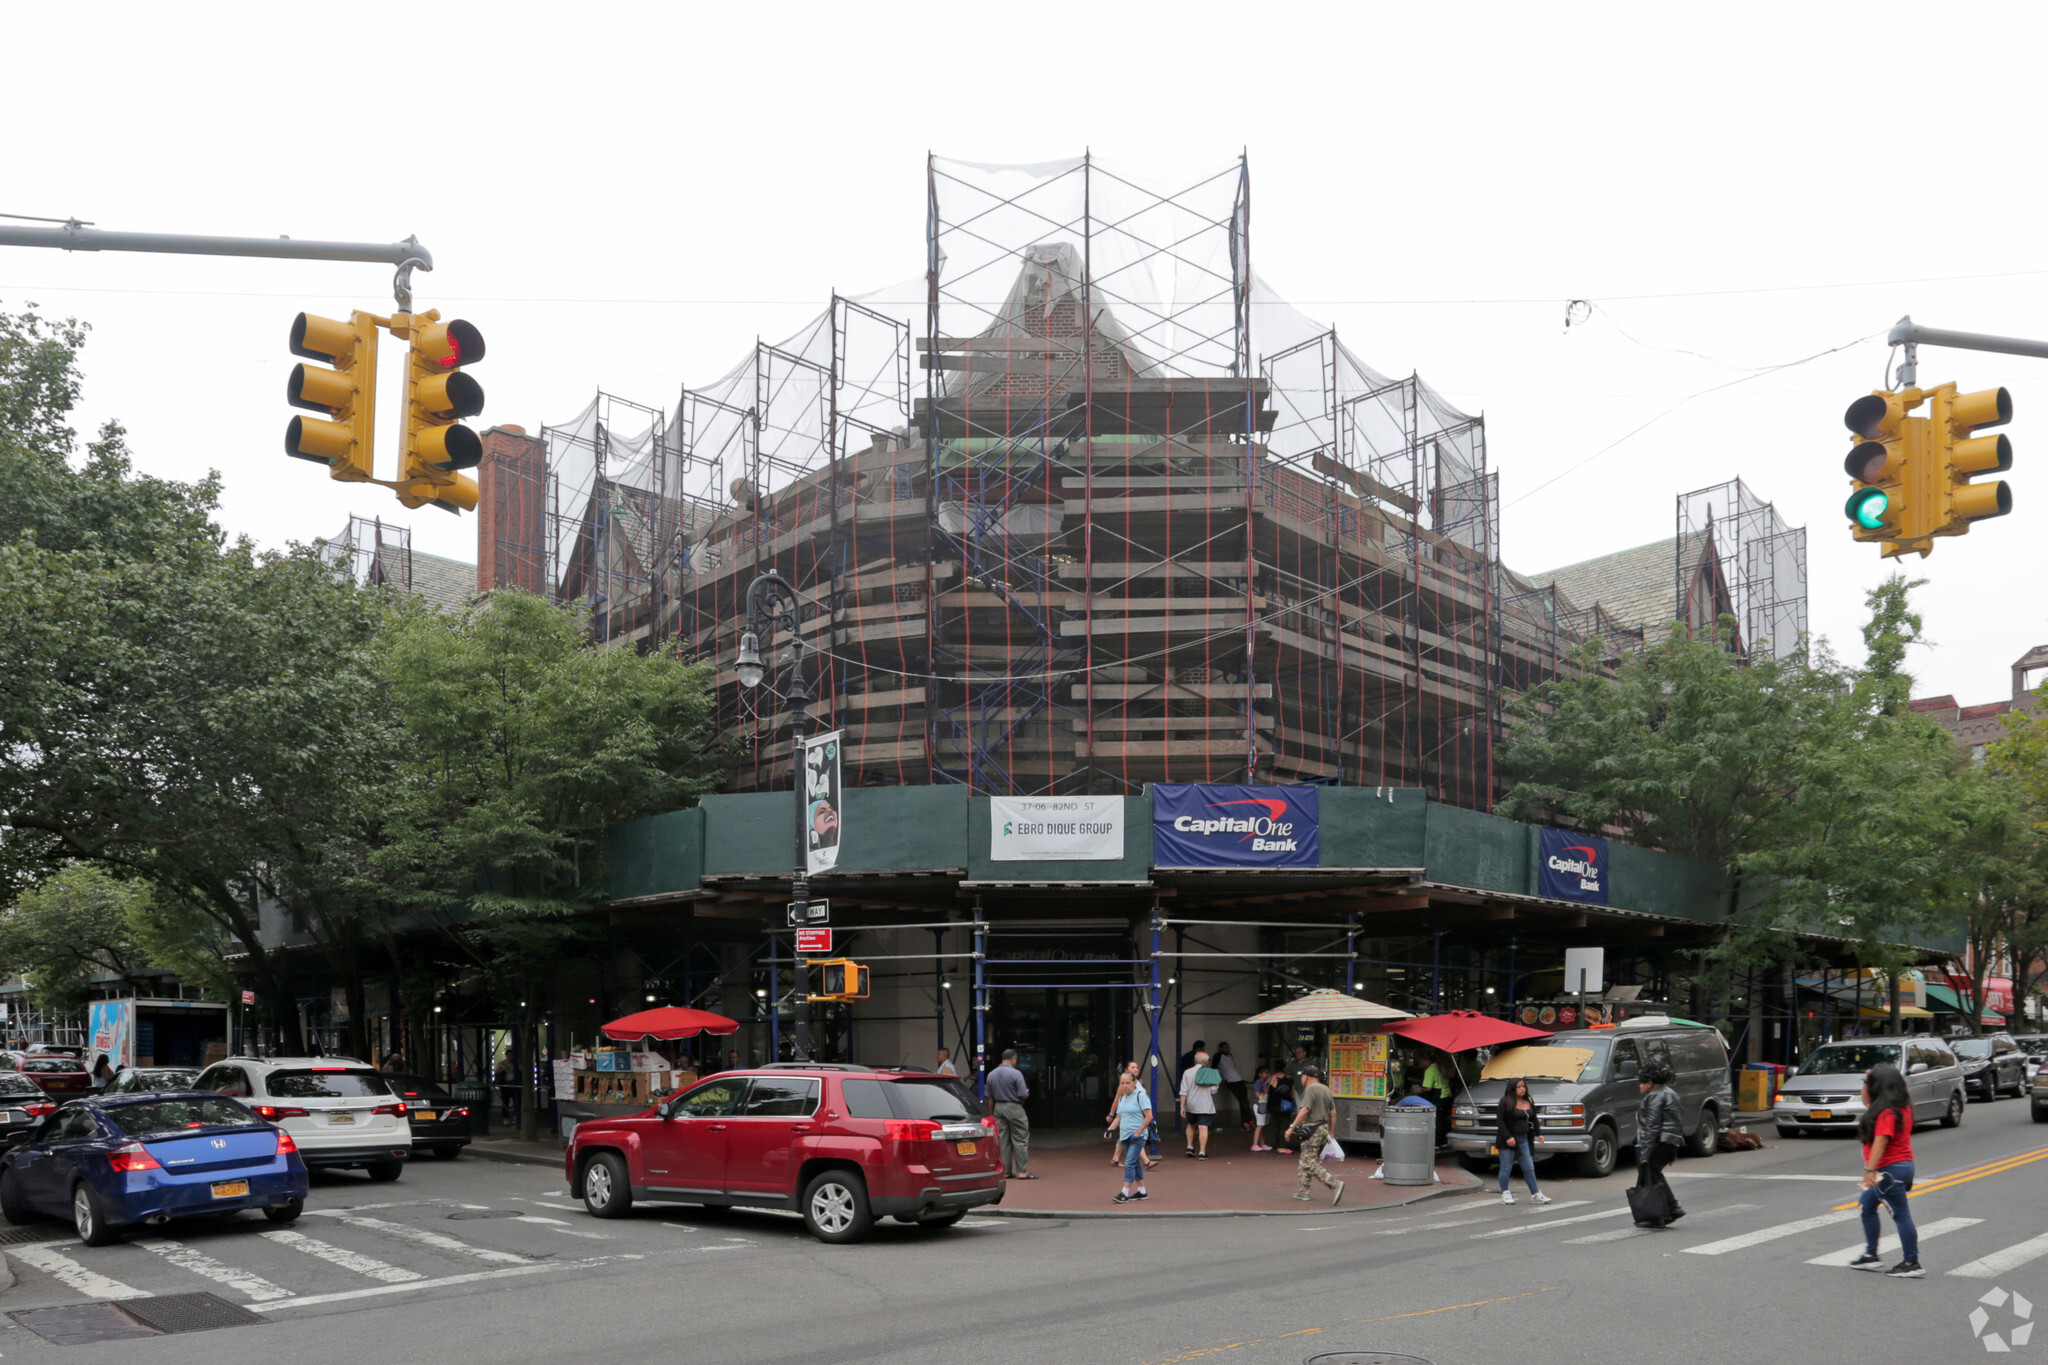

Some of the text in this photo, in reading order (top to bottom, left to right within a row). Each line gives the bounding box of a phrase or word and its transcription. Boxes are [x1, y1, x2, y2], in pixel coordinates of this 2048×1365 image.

[1021, 802, 1095, 811] 37-06 82ND ST
[1018, 823, 1113, 835] EBRO DIQUE GROUP
[1252, 838, 1297, 852] Bank
[1580, 878, 1600, 892] Bank
[810, 905, 824, 917] WAY
